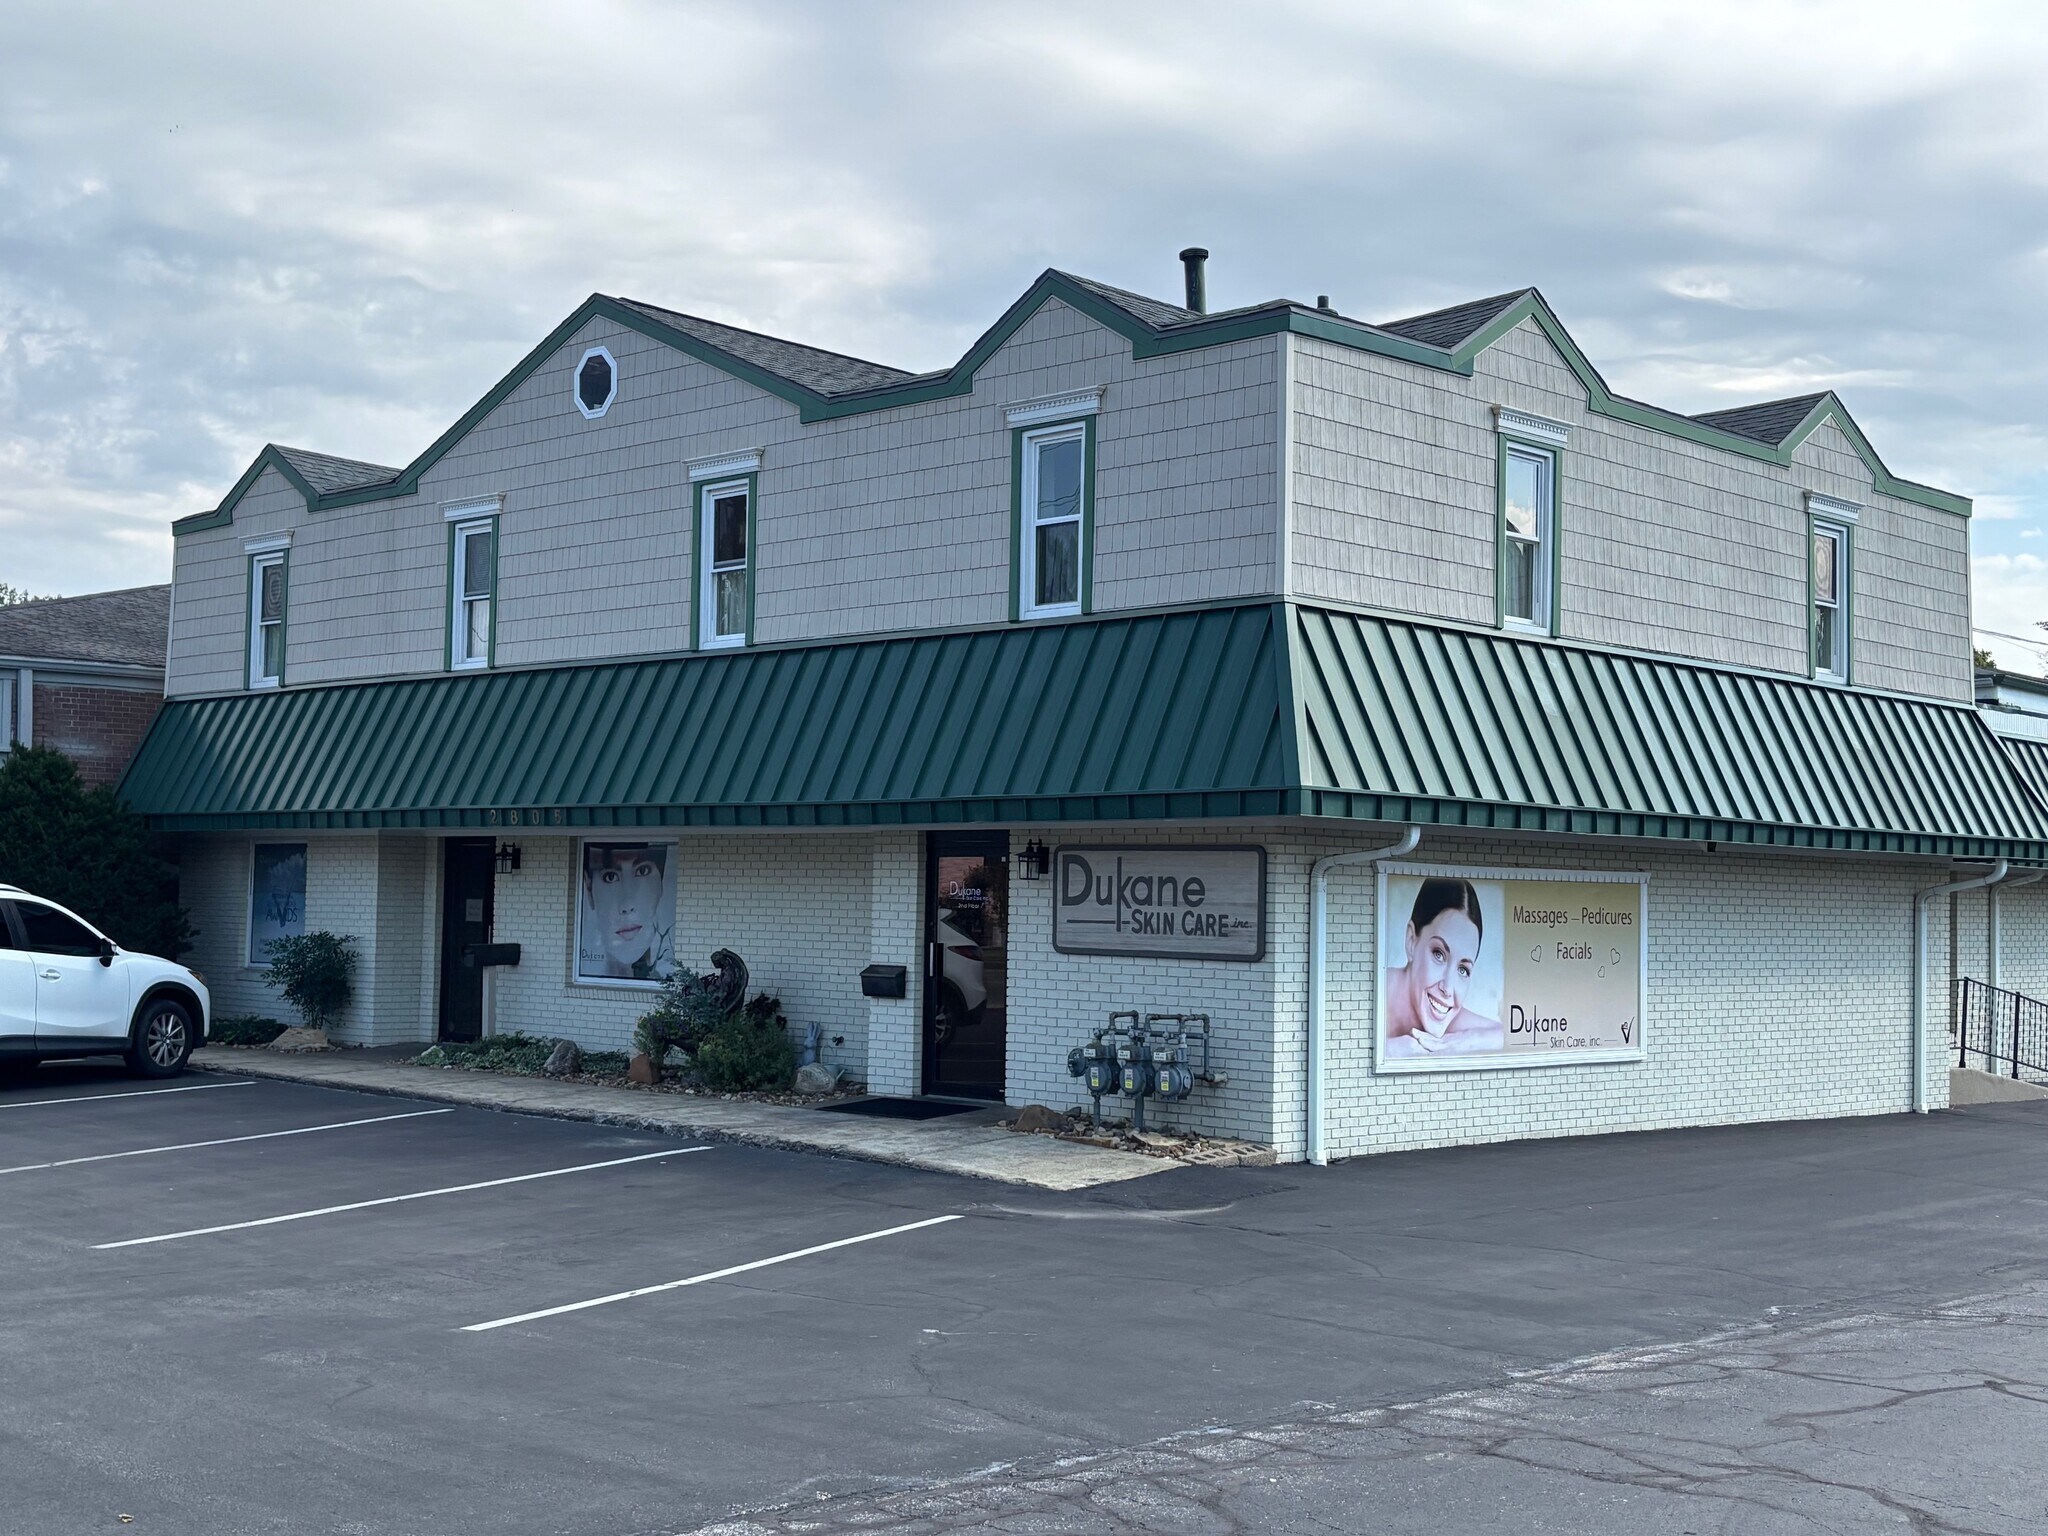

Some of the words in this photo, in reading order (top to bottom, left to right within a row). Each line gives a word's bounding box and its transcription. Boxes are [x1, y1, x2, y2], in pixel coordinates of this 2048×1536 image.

[950, 881, 981, 900] Dukane
[1061, 853, 1206, 931] Dukane
[1131, 908, 1175, 935] SKIN
[1181, 910, 1229, 937] CARE
[1513, 905, 1568, 928] Massages
[1581, 907, 1632, 926] Pedicures
[1556, 941, 1593, 960] Facials
[1510, 1004, 1568, 1046] Dukane
[1550, 1036, 1564, 1048] Skin
